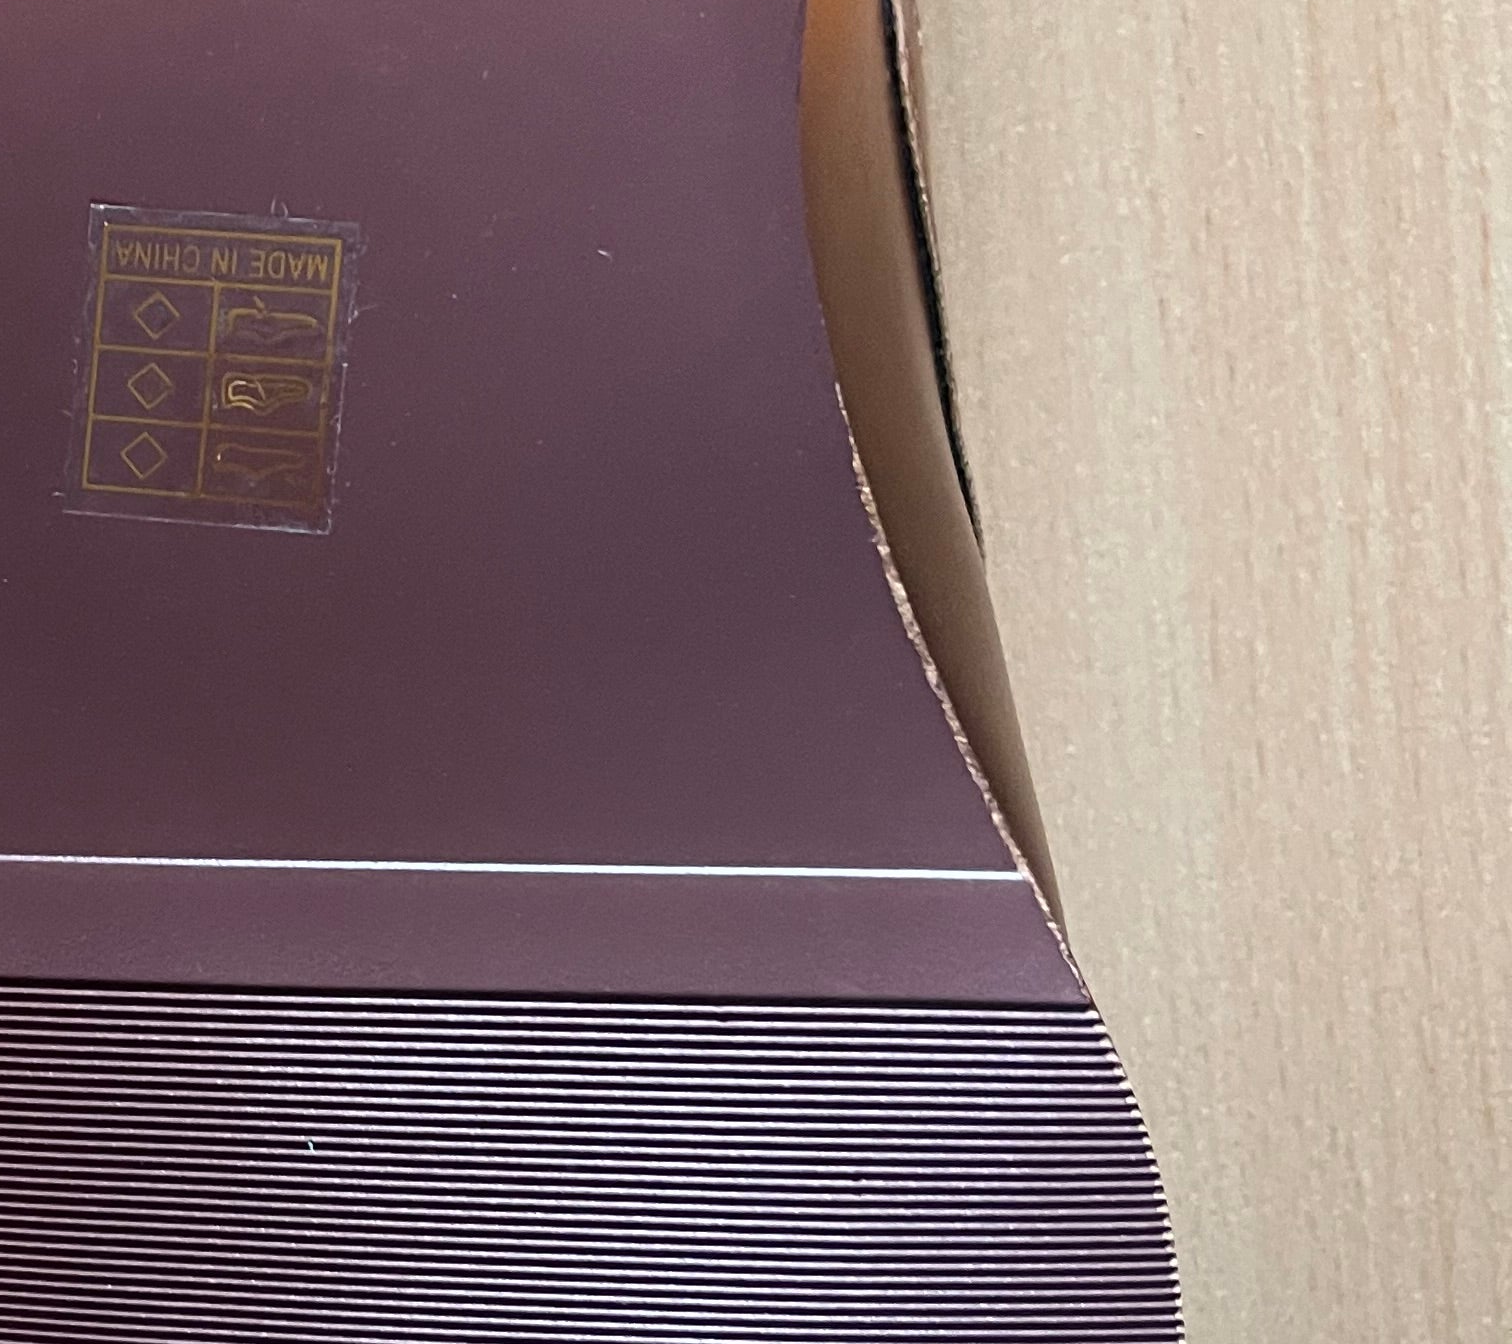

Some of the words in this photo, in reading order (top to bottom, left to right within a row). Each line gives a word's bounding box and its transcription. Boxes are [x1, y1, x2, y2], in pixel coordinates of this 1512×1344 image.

[114, 239, 200, 273] CHINA
[211, 246, 237, 274] IN
[249, 249, 327, 281] MADE
